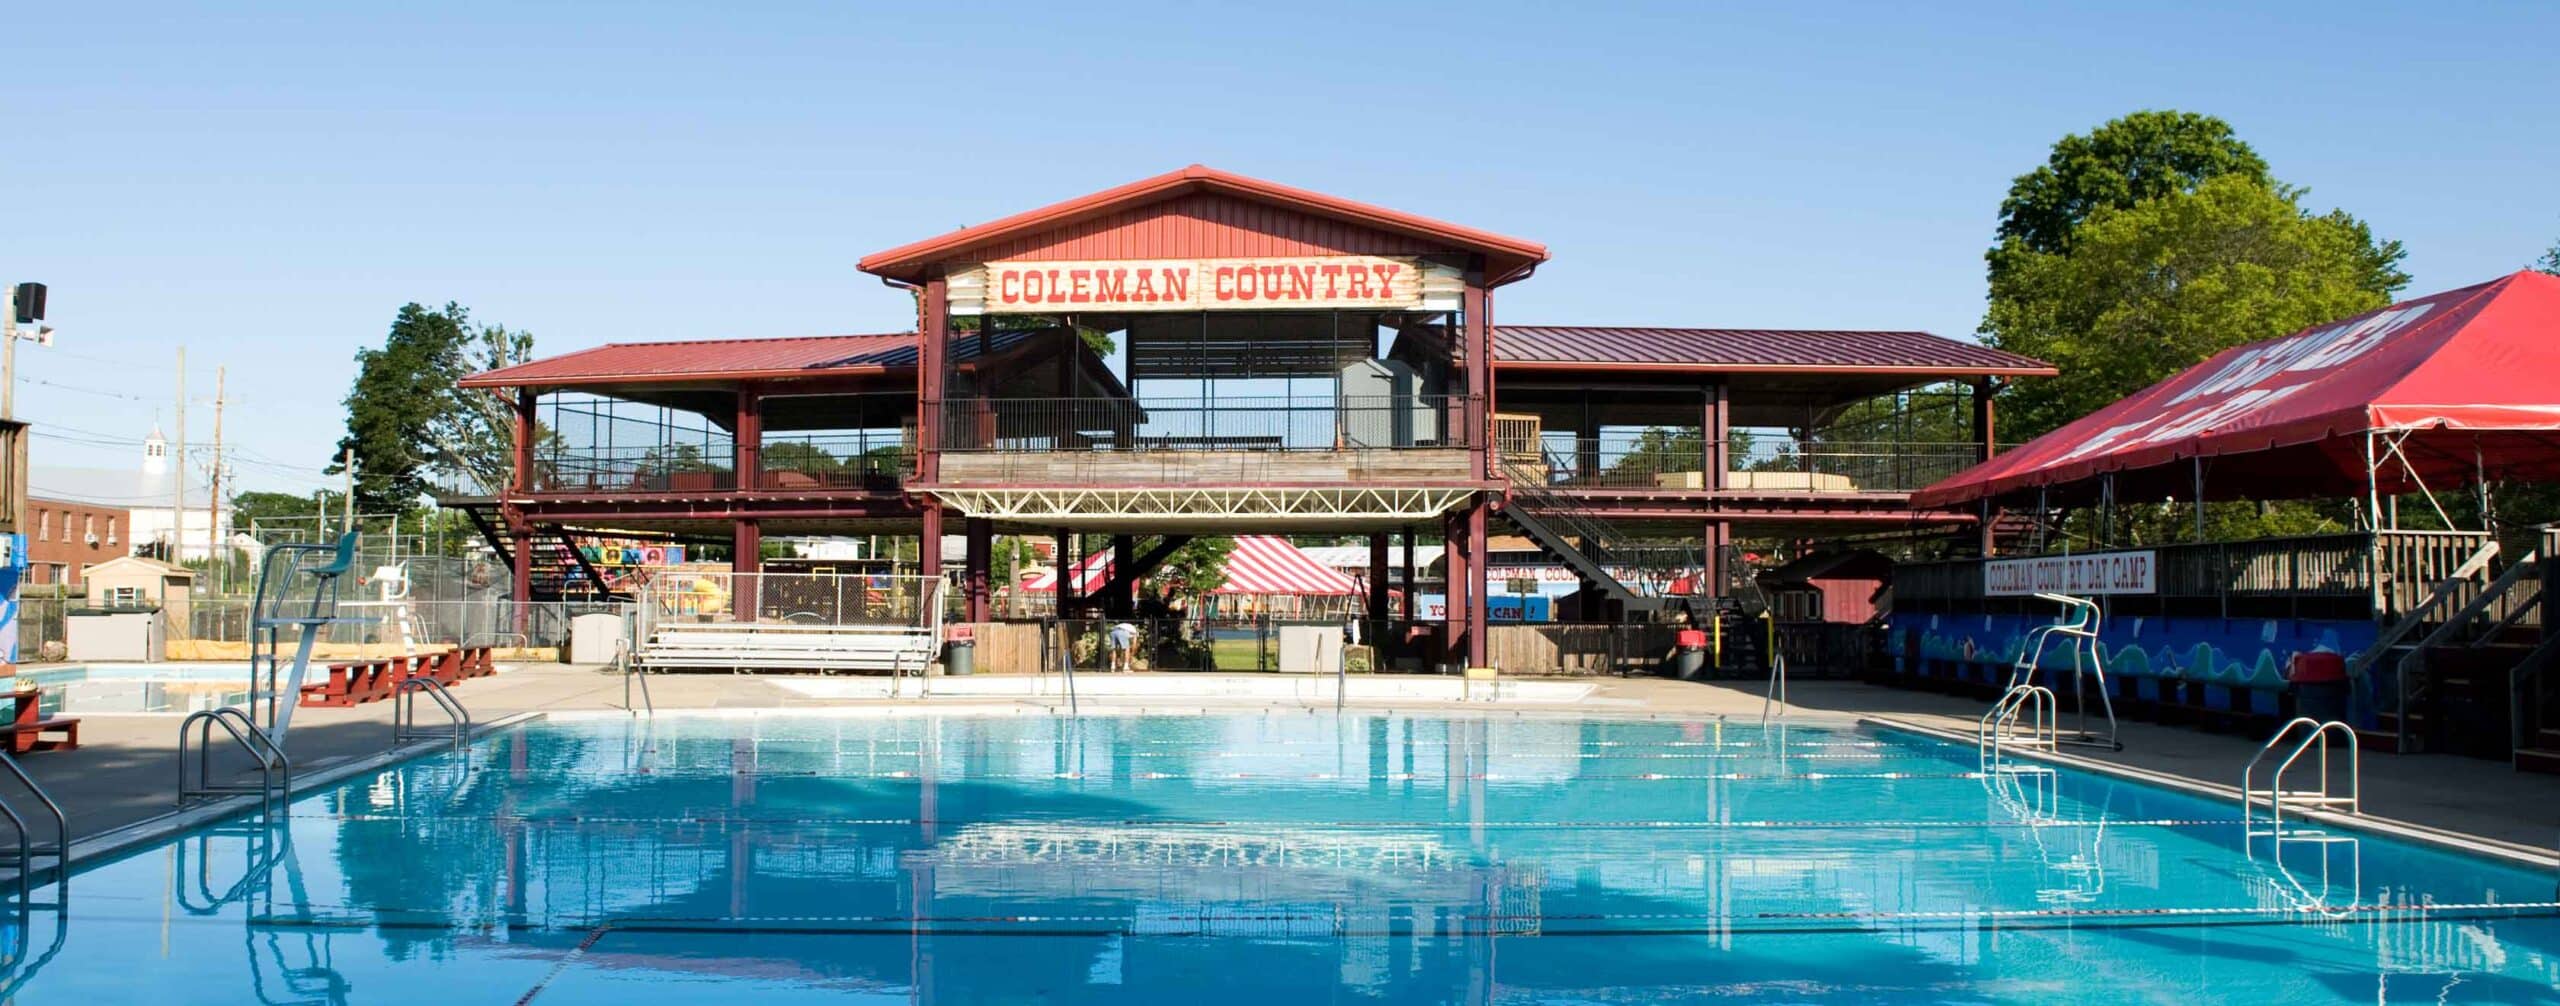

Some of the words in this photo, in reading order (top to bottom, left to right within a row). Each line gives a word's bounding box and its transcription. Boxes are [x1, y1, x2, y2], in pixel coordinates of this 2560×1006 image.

[1001, 267, 1190, 304] COLEMAN
[1215, 263, 1401, 301] COUNTRY
[1990, 562, 2033, 592] COLEMAN
[2036, 559, 2083, 591] COUNRY
[2087, 557, 2108, 590] DAY
[2112, 555, 2148, 590] CAMP
[1494, 607, 1521, 619] CAN
